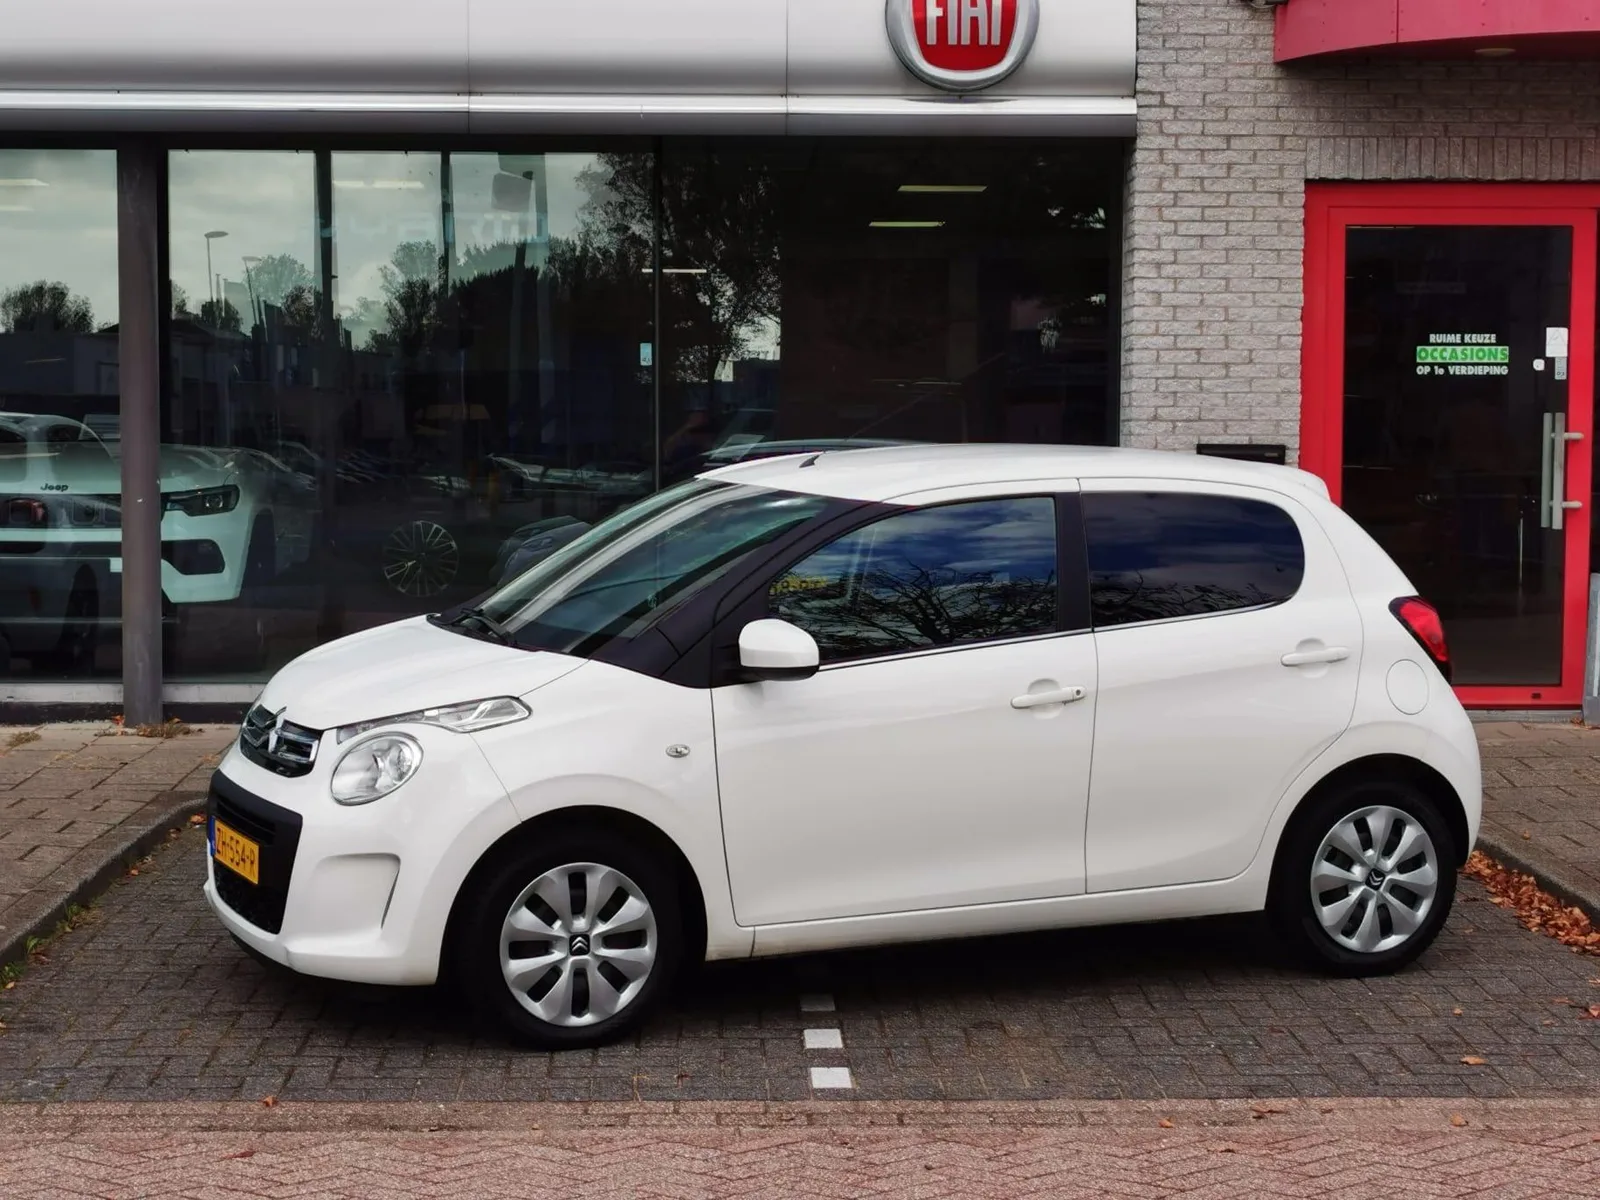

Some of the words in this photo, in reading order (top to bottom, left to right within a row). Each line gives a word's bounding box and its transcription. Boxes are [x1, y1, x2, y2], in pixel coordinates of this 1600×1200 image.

[1429, 334, 1461, 343] RUIME
[1464, 334, 1496, 343] KEUZE
[1417, 347, 1508, 361] OCCASIONS
[1416, 366, 1430, 375] OP
[1448, 366, 1508, 375] VERDIEPING
[41, 483, 69, 492] Jeep
[217, 827, 255, 877] ZH-554-R
